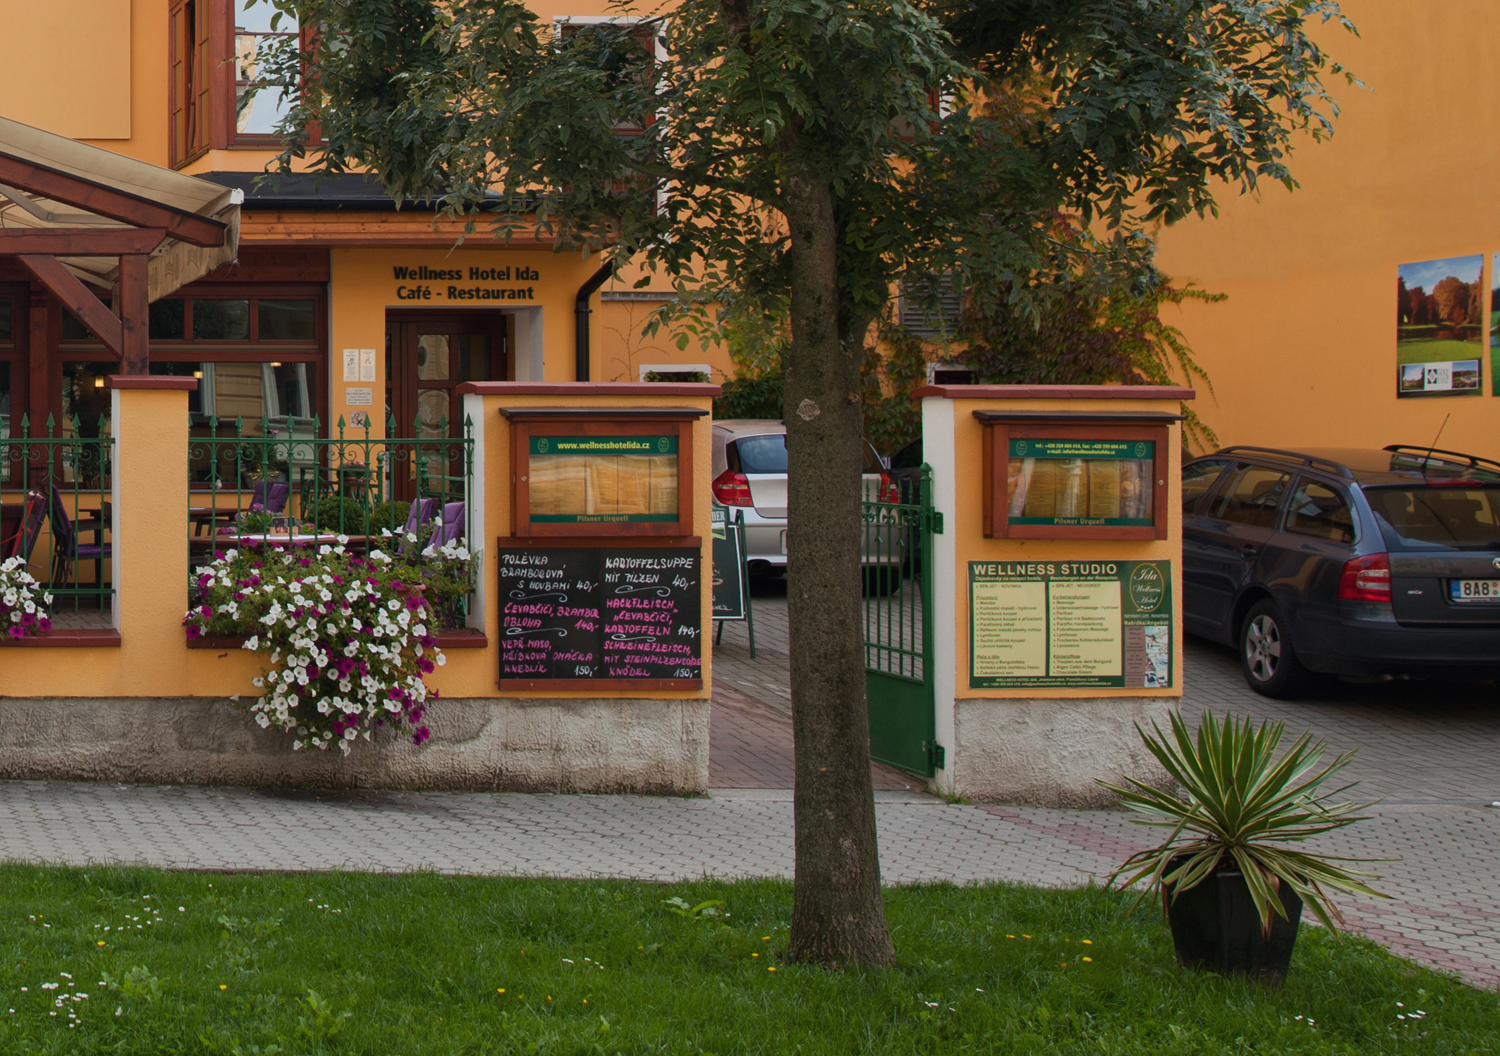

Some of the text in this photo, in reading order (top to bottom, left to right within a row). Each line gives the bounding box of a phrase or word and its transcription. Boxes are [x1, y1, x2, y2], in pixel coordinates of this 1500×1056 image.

[393, 266, 539, 281] Wellness Hotel Ida
[396, 285, 431, 300] Café
[447, 286, 534, 300] Restaurant
[557, 441, 650, 450] www.wellnesshotelida.cz
[604, 515, 629, 523] Urquell
[1054, 517, 1105, 526] Pilsner Urquell
[973, 564, 1117, 575] WELLNESS STUDIO
[1133, 567, 1158, 581] Ida
[1463, 582, 1490, 596] 8A8
